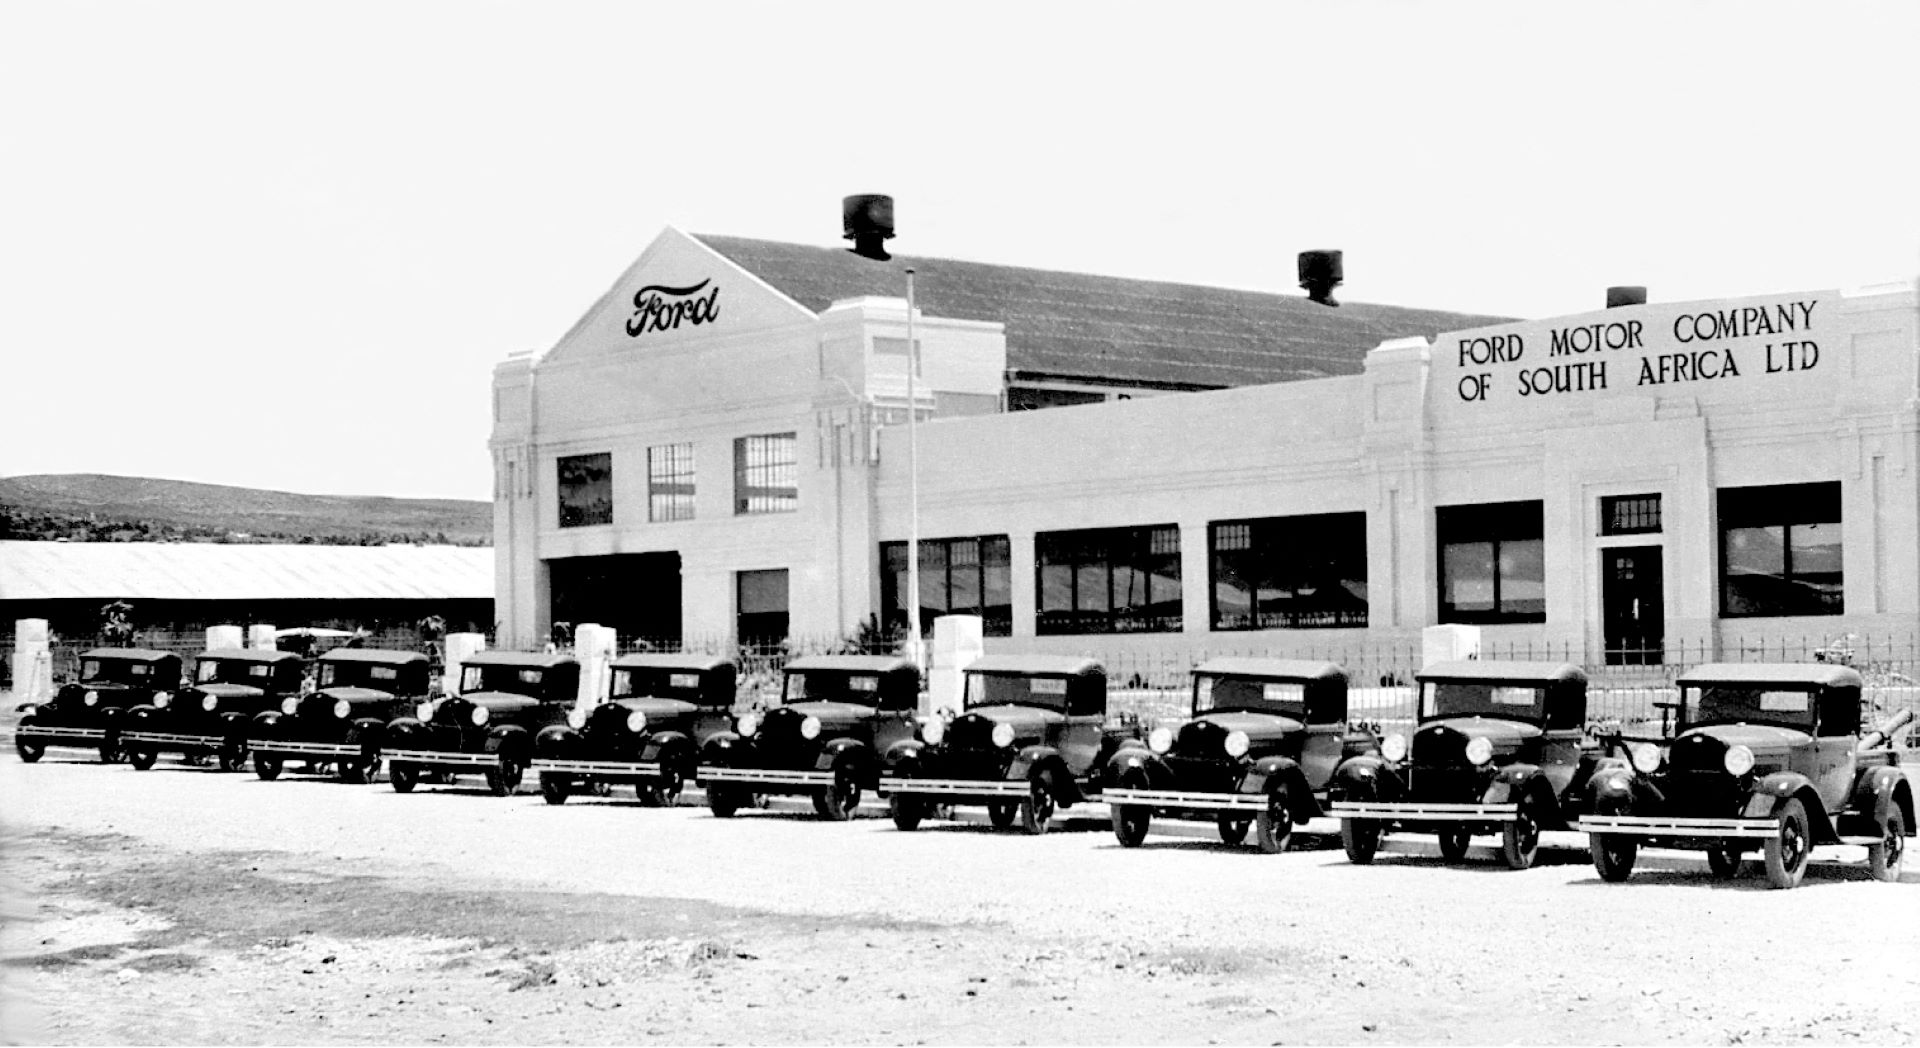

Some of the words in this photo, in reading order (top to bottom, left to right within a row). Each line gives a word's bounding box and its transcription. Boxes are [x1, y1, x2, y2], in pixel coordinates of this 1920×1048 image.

[625, 278, 720, 338] Ford
[1458, 333, 1524, 367] FORD
[1549, 320, 1643, 358] MOTOR
[1673, 300, 1817, 343] COMPANY
[1458, 373, 1492, 402] OF
[1518, 360, 1608, 397] SOUTH
[1637, 348, 1741, 386] AFRICA
[1765, 340, 1819, 374] LTD
